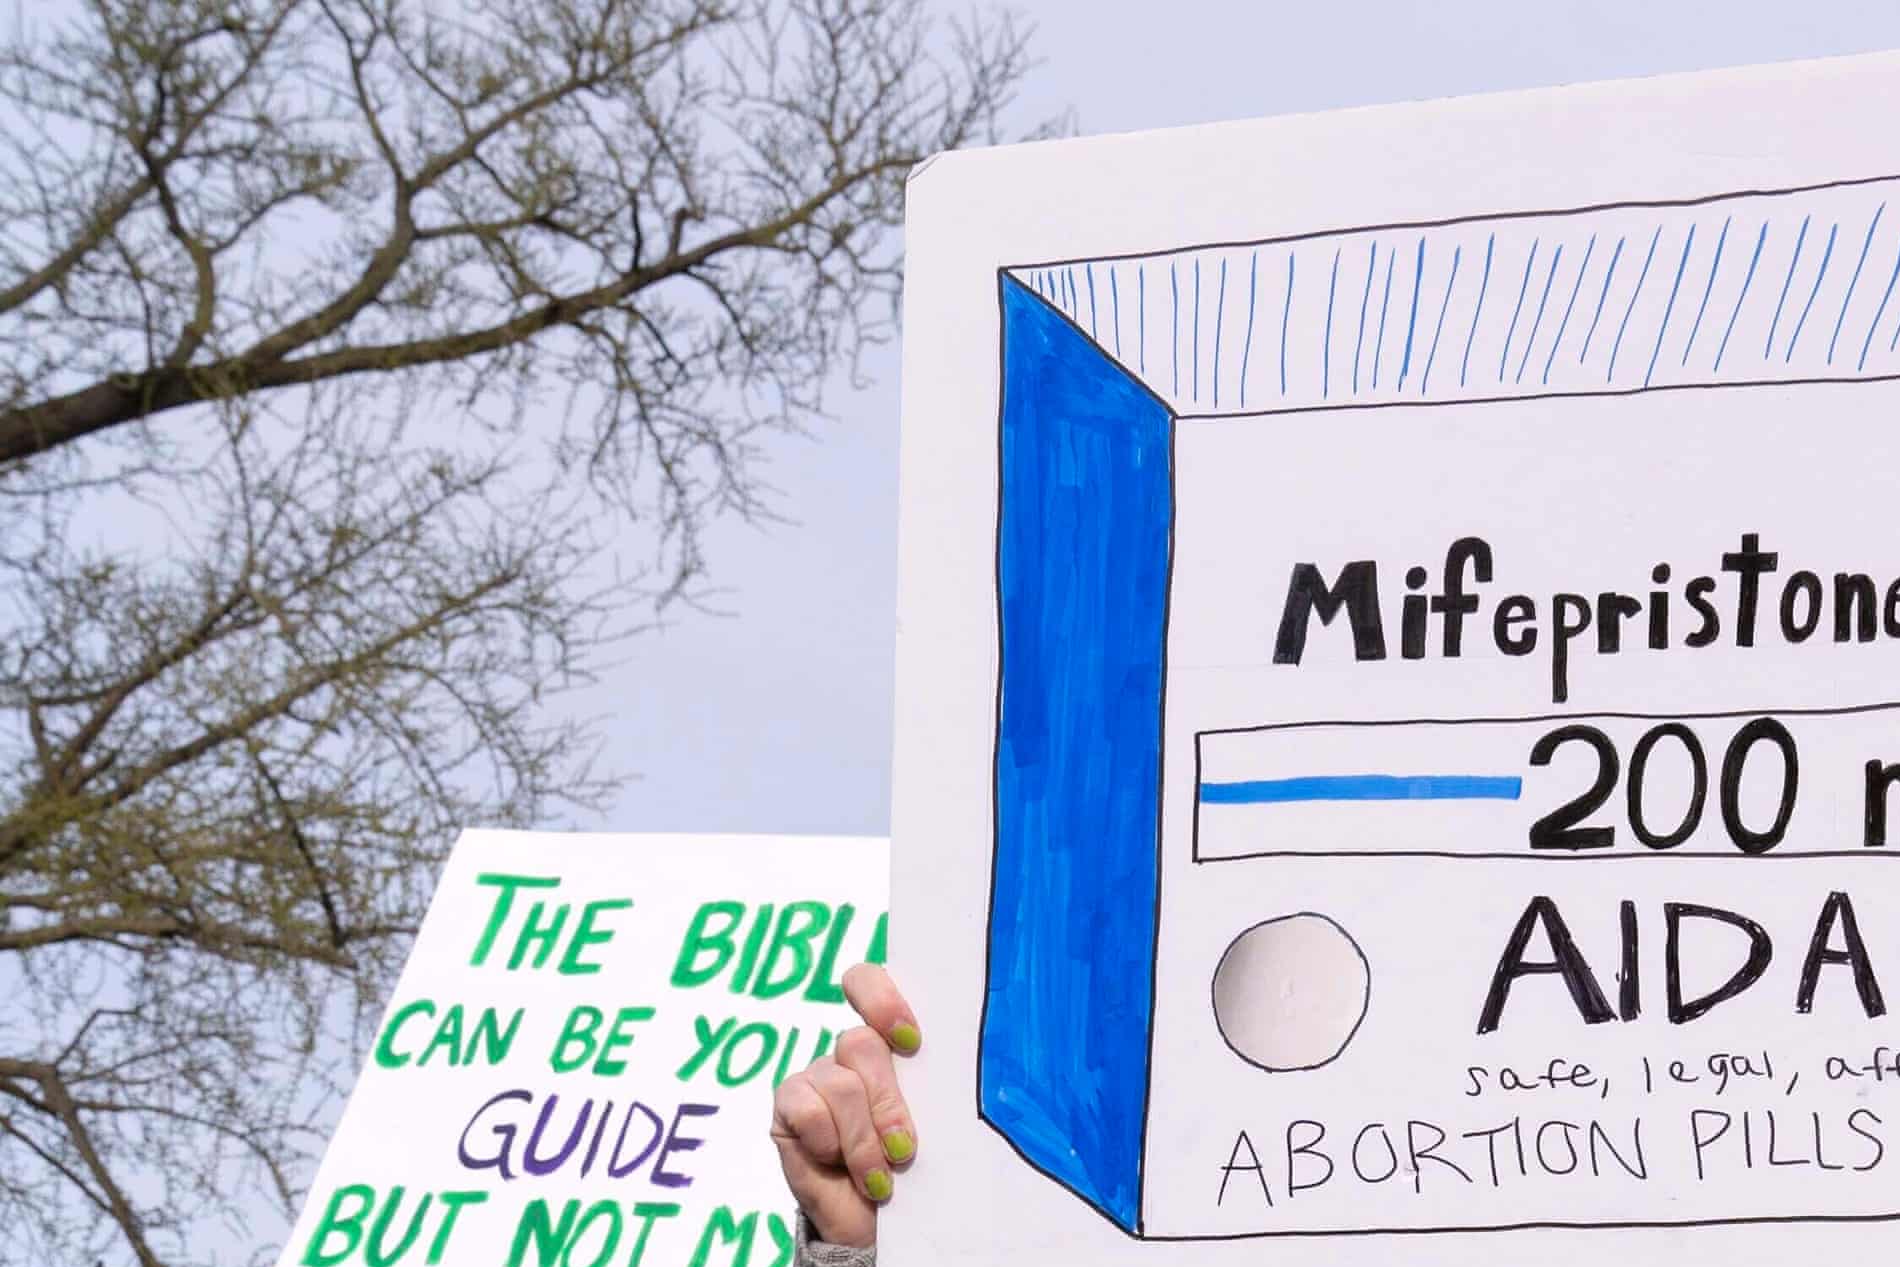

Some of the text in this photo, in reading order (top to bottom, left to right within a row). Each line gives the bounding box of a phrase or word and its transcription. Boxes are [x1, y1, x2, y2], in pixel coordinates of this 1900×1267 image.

[1528, 717, 1799, 854] 200
[468, 872, 634, 976] THE
[374, 999, 840, 1089] CAN BE YOU
[1465, 1058, 1610, 1099] safe,
[1642, 1050, 1799, 1096] legal,
[457, 1089, 720, 1188] GUIDE
[1218, 1116, 1648, 1207] ABORTION
[1691, 1109, 1884, 1180] PILLS
